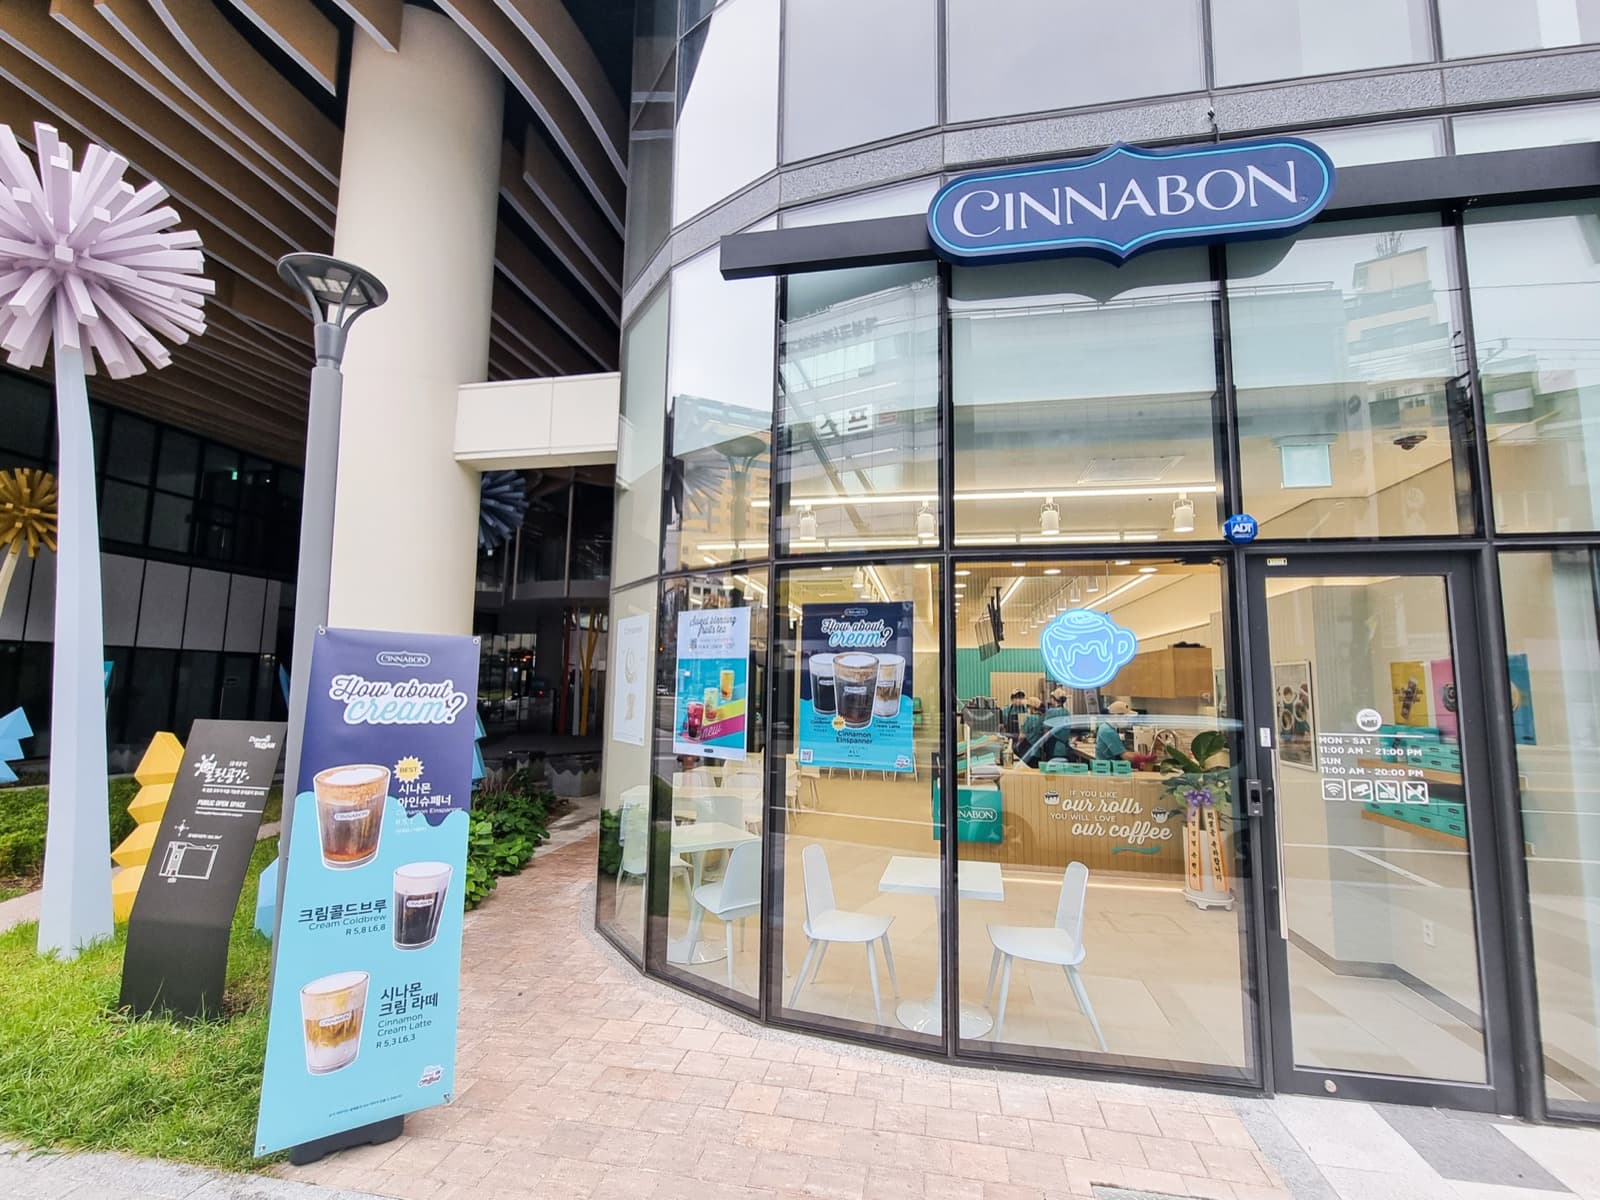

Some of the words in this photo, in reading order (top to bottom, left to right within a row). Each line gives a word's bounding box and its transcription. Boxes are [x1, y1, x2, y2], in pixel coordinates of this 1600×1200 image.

[953, 160, 1299, 238] CINNABON
[1232, 523, 1252, 533] ADT
[822, 619, 850, 634] How
[852, 619, 884, 632] about
[829, 628, 893, 647] cream?
[380, 654, 426, 664] CINNABON
[331, 676, 389, 701] How
[393, 680, 450, 699] about
[346, 694, 466, 722] cream?
[837, 730, 871, 738] Cinnamon
[1319, 736, 1343, 744] MON
[1353, 737, 1372, 745] SAT
[1319, 746, 1344, 754] 11:00
[1347, 747, 1364, 755] AM
[1375, 748, 1404, 756] 21:00
[1407, 748, 1422, 756] PM
[1320, 757, 1341, 765] SUN
[1320, 766, 1345, 774] 11:00
[1349, 767, 1365, 775] AM
[1375, 768, 1405, 777] 20:00
[1408, 769, 1424, 777] PM
[398, 783, 432, 796] 시나몬
[1080, 790, 1097, 798] YOU
[1099, 791, 1118, 799] LIKE
[1062, 798, 1095, 812] our
[1098, 797, 1143, 814] rolls
[958, 810, 993, 819] NABON
[1071, 813, 1089, 821] WILL
[1095, 814, 1116, 823] LOVE
[1071, 822, 1106, 837] our
[1109, 820, 1173, 845] coffee
[298, 898, 387, 923] 크림콜드브루
[309, 919, 340, 931] Cream
[343, 914, 387, 926] Coldbrew
[345, 928, 352, 936] R
[380, 982, 422, 1002] 시나몬
[378, 999, 407, 1017] 크림
[412, 992, 439, 1010] 라떼
[377, 1024, 407, 1037] Cream
[409, 1018, 433, 1031] Latte
[378, 1012, 423, 1029] Cinnamon
[376, 1041, 382, 1049] R
